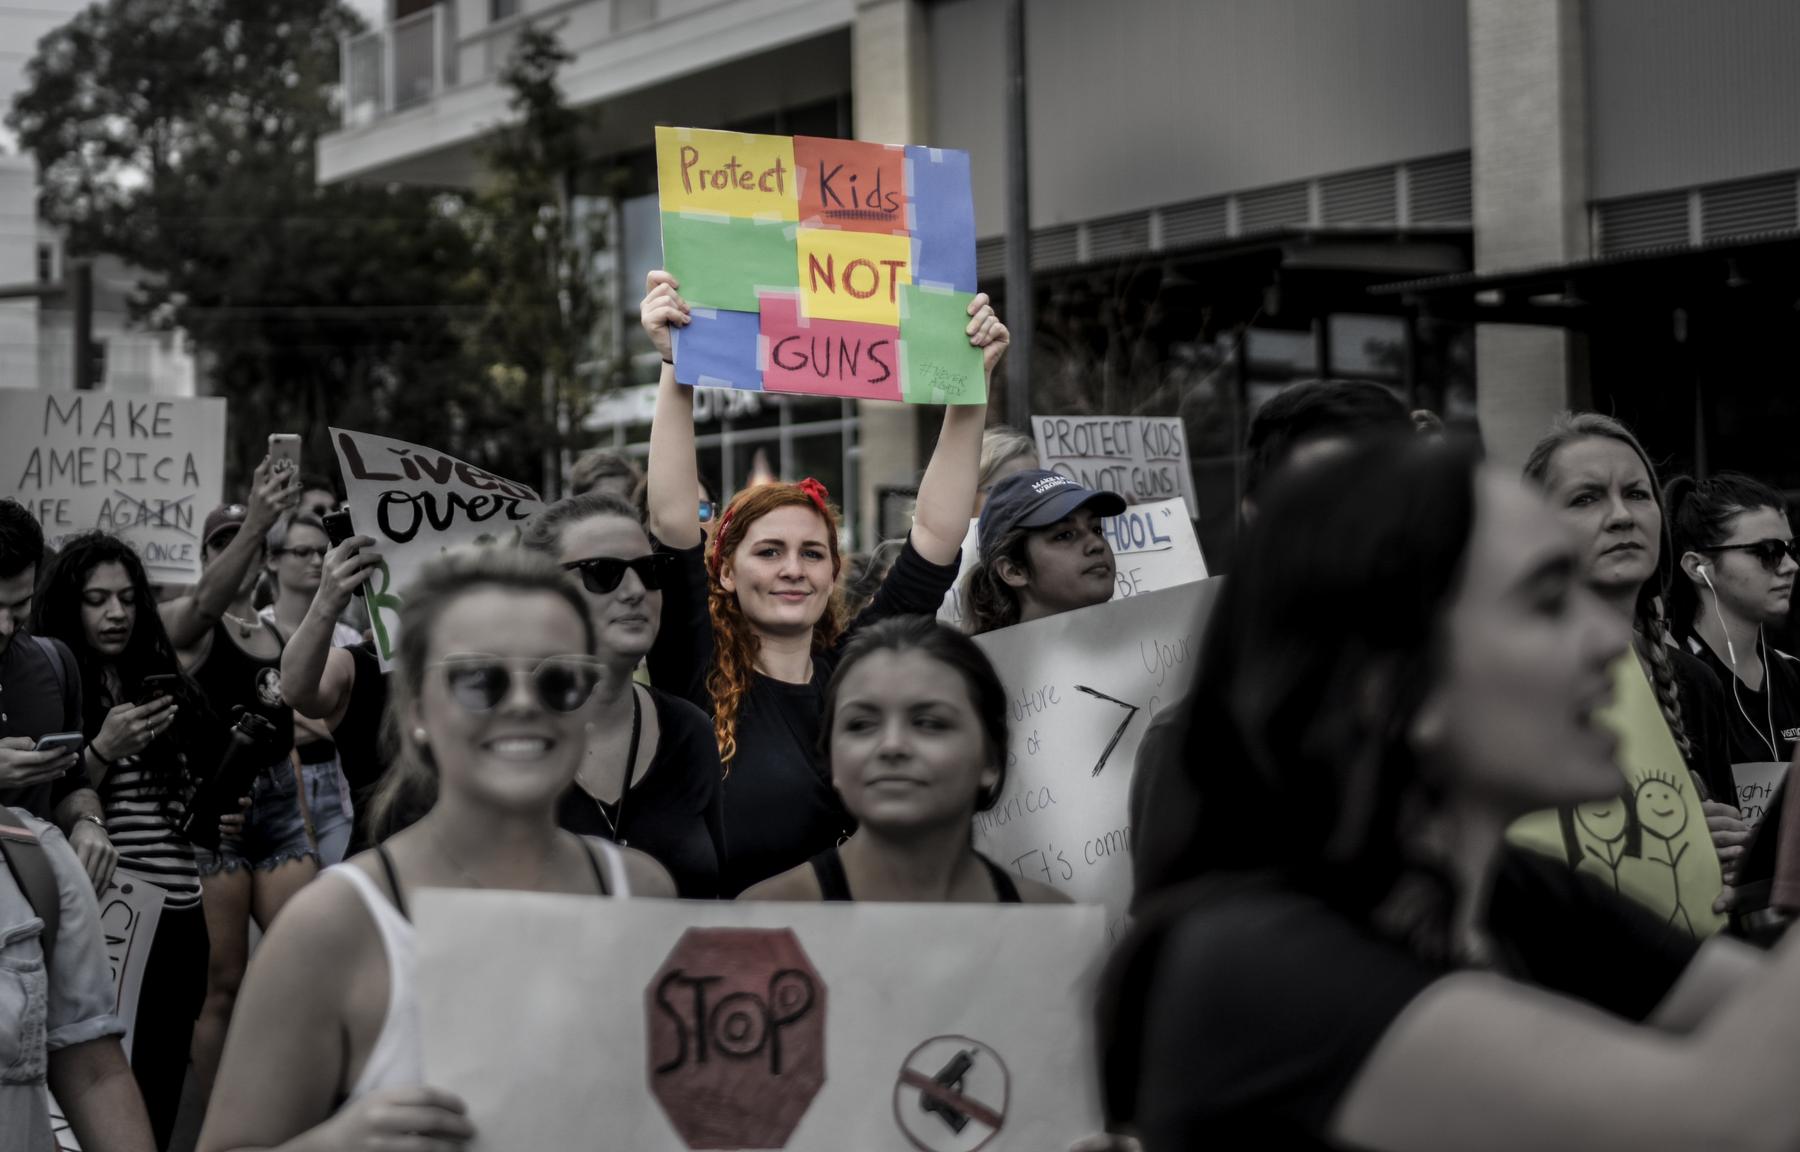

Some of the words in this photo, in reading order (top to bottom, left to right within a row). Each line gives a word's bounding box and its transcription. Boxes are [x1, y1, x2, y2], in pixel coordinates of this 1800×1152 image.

[681, 145, 786, 195] Protect
[819, 160, 900, 213] Kids
[808, 253, 906, 304] NOT
[772, 336, 891, 384] GUNS
[44, 395, 173, 438] MAKE
[1042, 419, 1133, 457] PROTECT
[1141, 419, 1182, 458] KIDS
[18, 447, 200, 490] AMERICA
[1081, 465, 1127, 493] NOT
[1131, 466, 1182, 497] GUNS!
[96, 498, 193, 528] AGAIN
[145, 541, 193, 562] ONCE
[1140, 634, 1192, 687] Your
[1013, 685, 1061, 721] uture
[978, 786, 1056, 836] merica
[656, 968, 815, 1075] STOP
